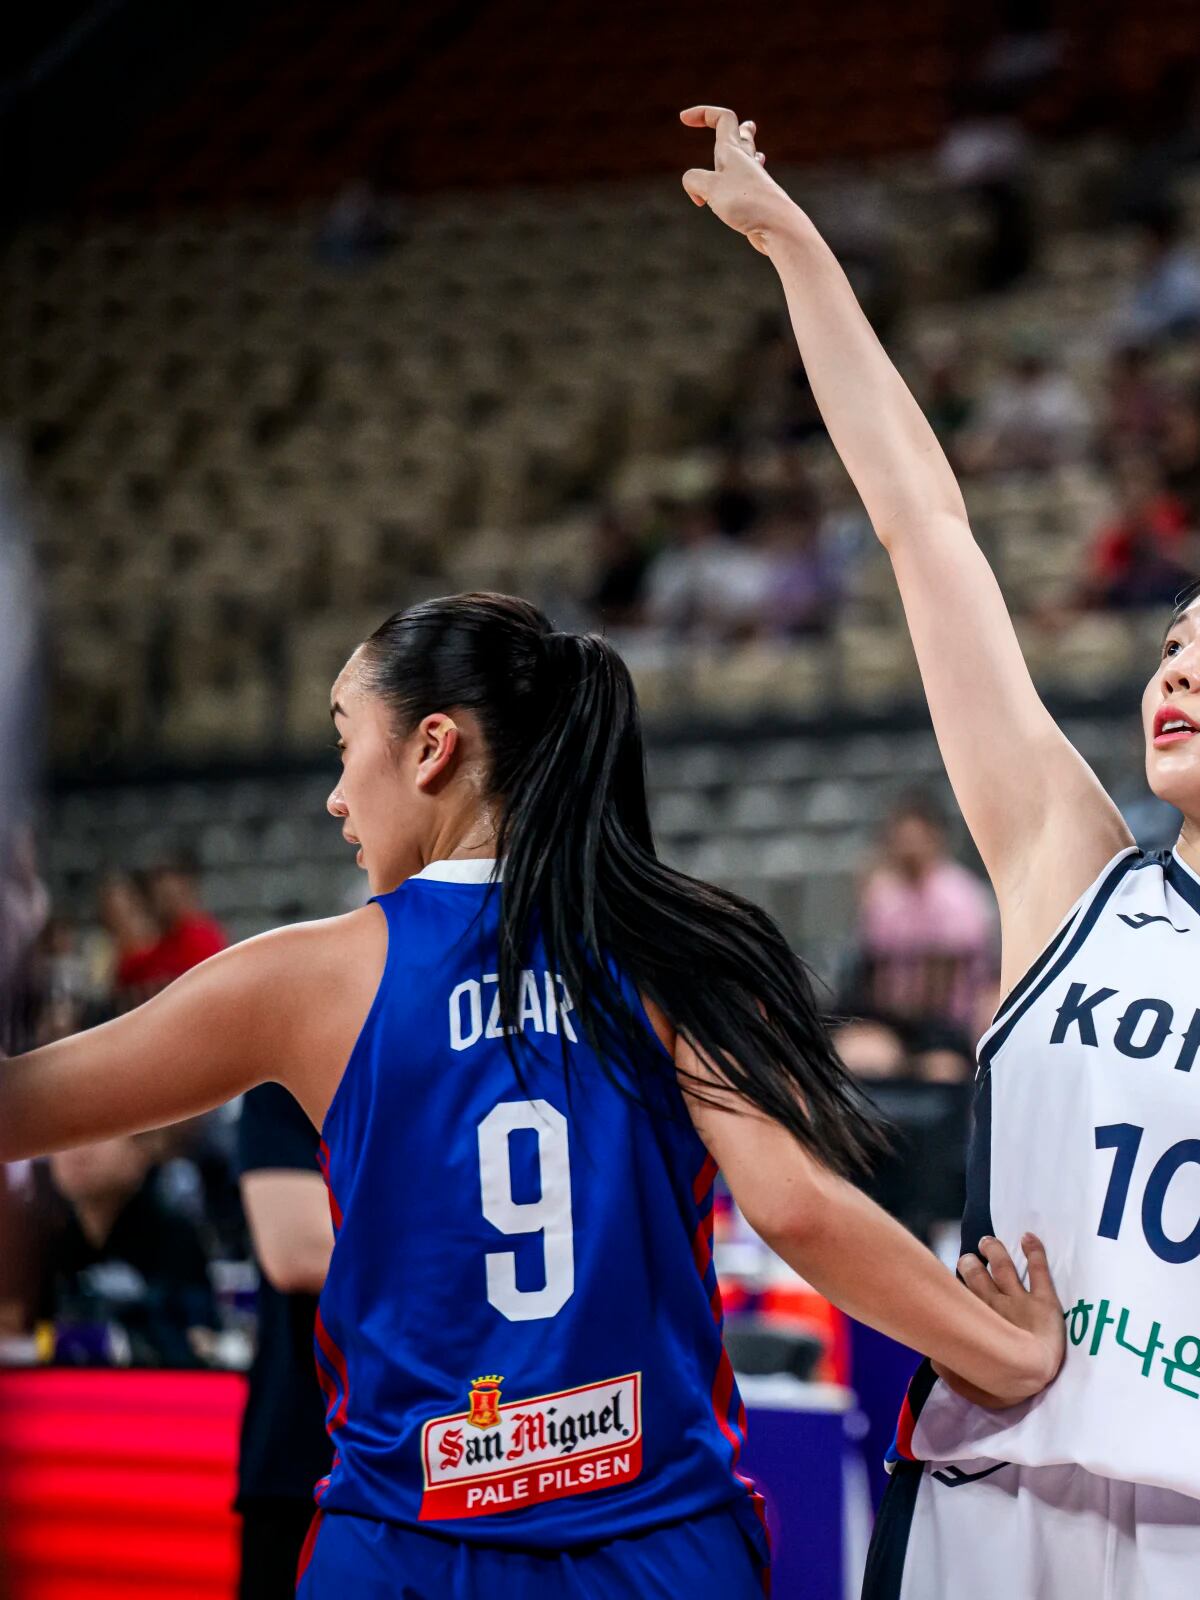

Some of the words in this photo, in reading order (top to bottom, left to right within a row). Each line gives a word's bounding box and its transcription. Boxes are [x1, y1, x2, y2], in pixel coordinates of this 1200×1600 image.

[449, 969, 578, 1051] OZAR
[477, 1099, 574, 1321] 9
[438, 1427, 503, 1470] San
[507, 1390, 624, 1460] Miguel
[466, 1478, 529, 1509] PALE
[538, 1453, 631, 1493] PILSEN
